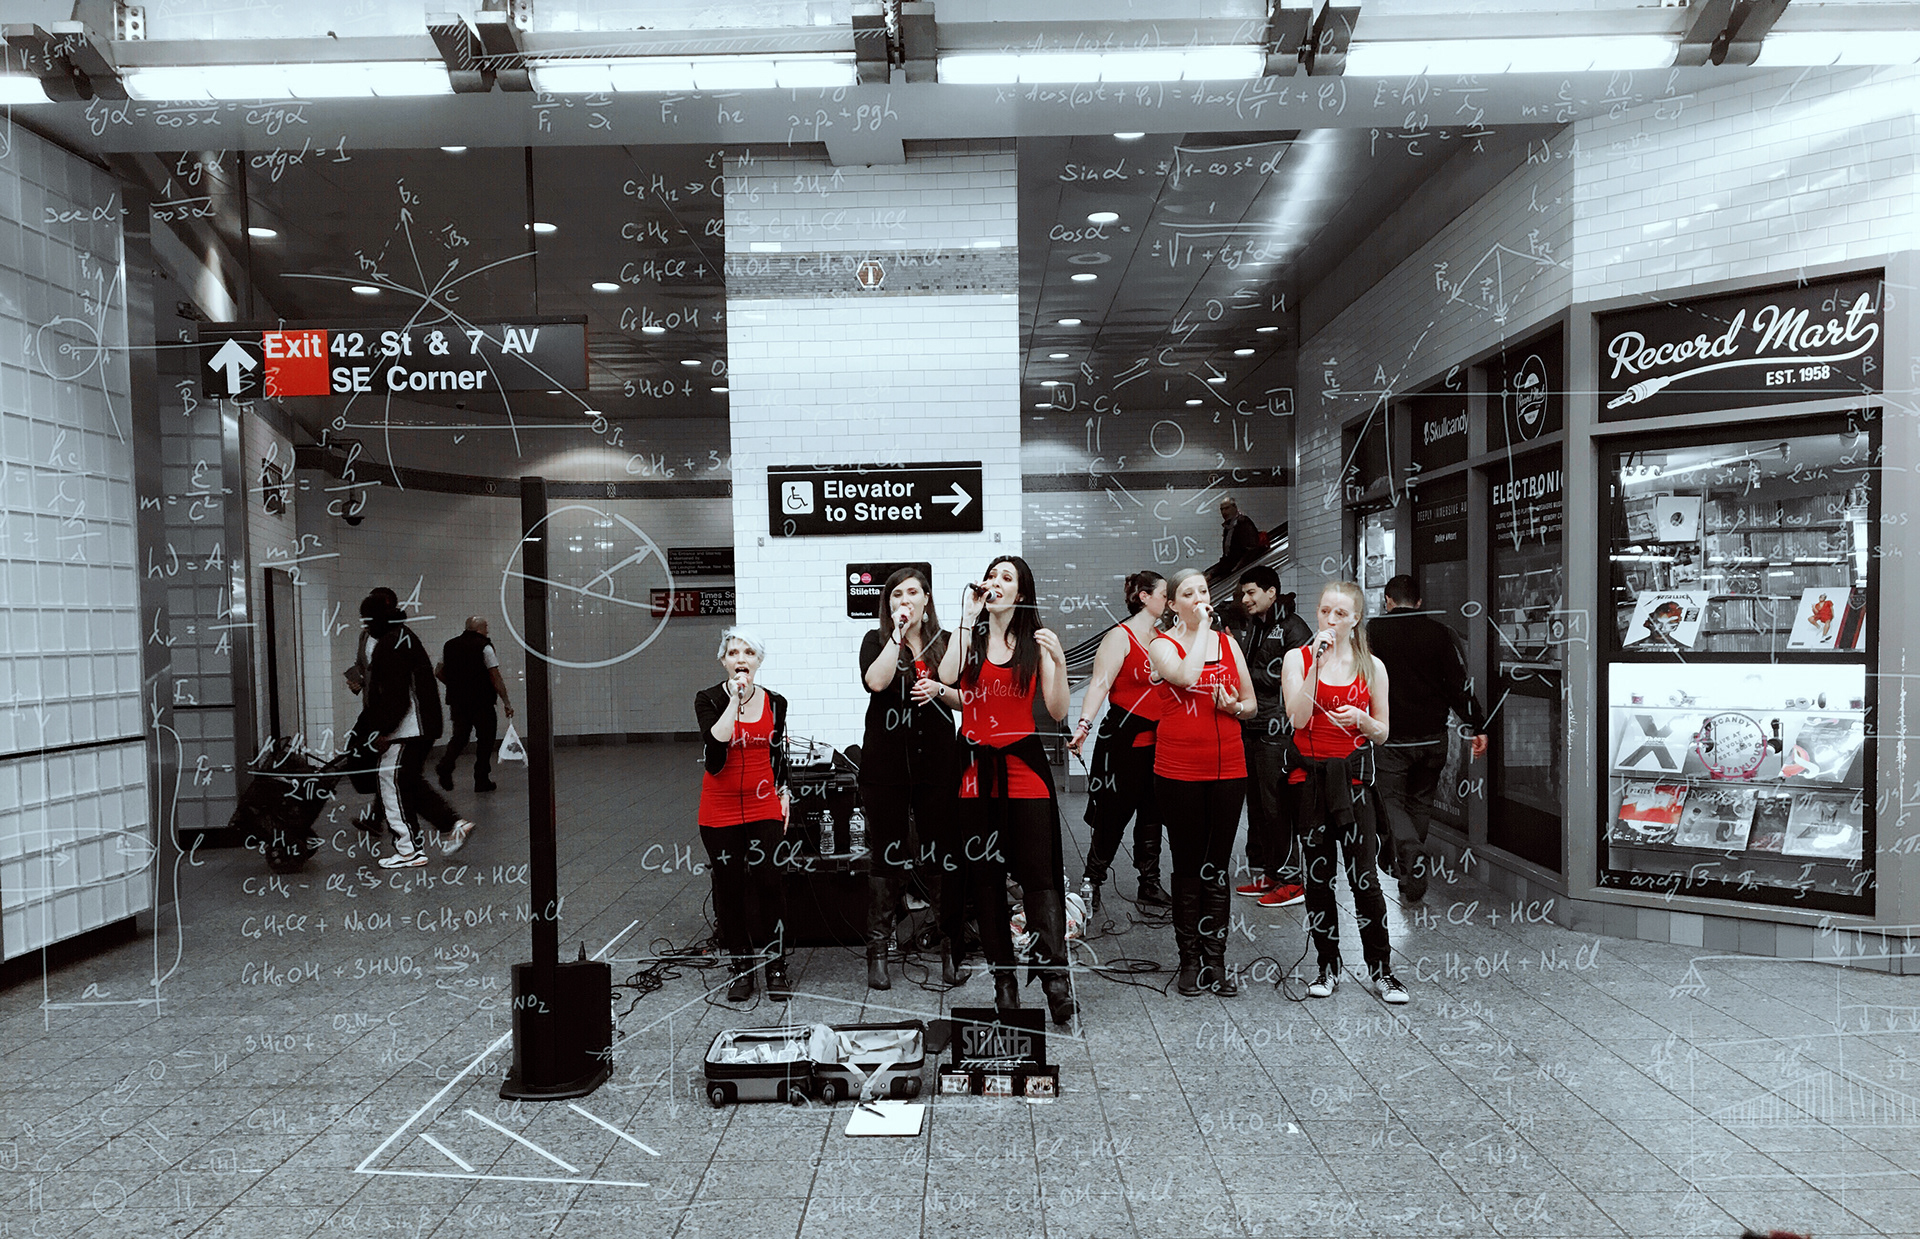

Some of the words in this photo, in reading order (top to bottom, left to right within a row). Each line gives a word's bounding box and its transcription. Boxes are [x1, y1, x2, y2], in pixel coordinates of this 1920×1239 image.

[264, 332, 323, 359] Exit
[331, 333, 365, 357] 42
[381, 331, 412, 357] St
[428, 331, 449, 355] &
[468, 331, 484, 355] 7
[501, 328, 539, 354] AV
[1607, 308, 1746, 378] Record
[1754, 292, 1877, 355] Mart
[332, 367, 372, 391] SE
[386, 365, 487, 391] Corner
[1766, 370, 1796, 386] EST.
[1799, 365, 1830, 383] 1958
[823, 480, 915, 498] Elevator
[825, 504, 847, 521] to
[854, 502, 922, 521] Street
[651, 593, 694, 612] Exit
